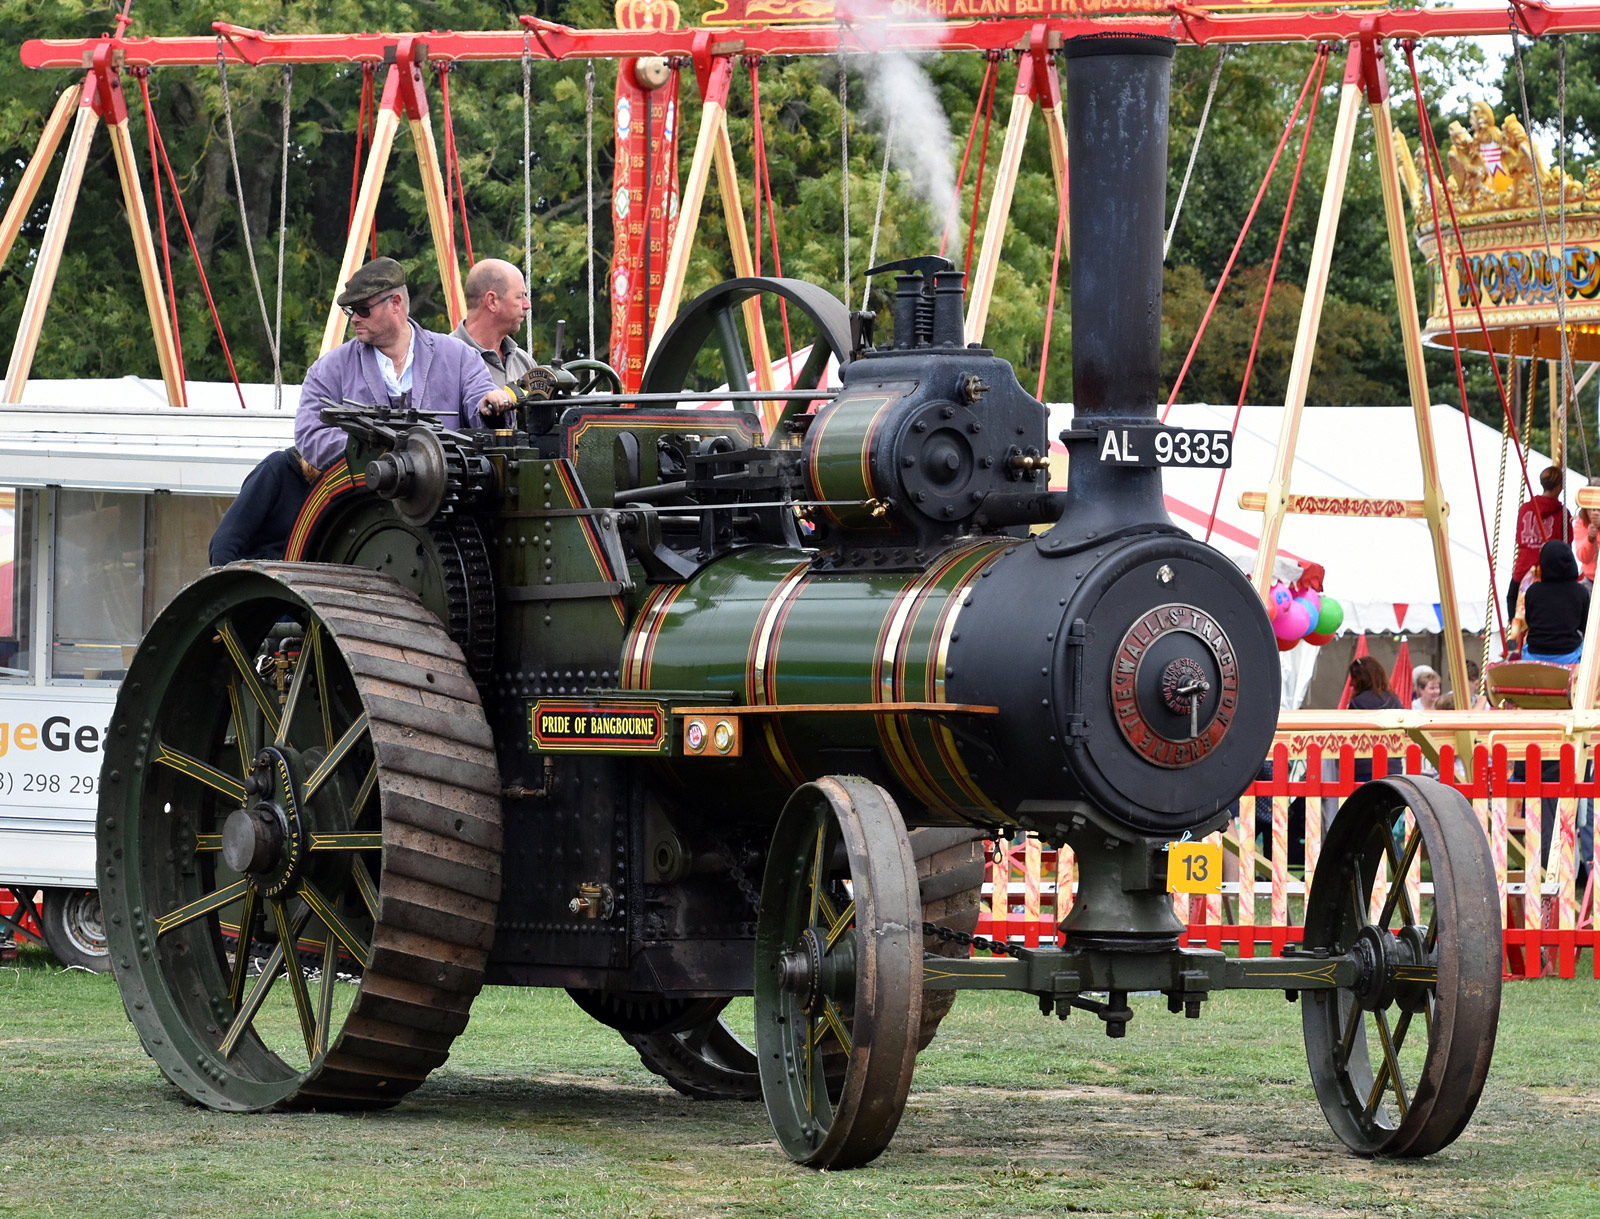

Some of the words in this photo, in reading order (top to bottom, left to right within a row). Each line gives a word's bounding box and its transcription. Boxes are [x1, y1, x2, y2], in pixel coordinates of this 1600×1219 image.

[627, 323, 643, 336] 135
[627, 357, 642, 370] 125
[1100, 430, 1139, 462] AL
[1154, 431, 1229, 464] 9335
[1190, 610, 1237, 727] TRACTION
[541, 715, 571, 734] PRIDE
[574, 716, 588, 734] OF
[590, 716, 655, 736] BANGBOURNE
[1137, 727, 1212, 764] ENGINE
[22, 773, 61, 794] 298
[1181, 854, 1209, 882] 13
